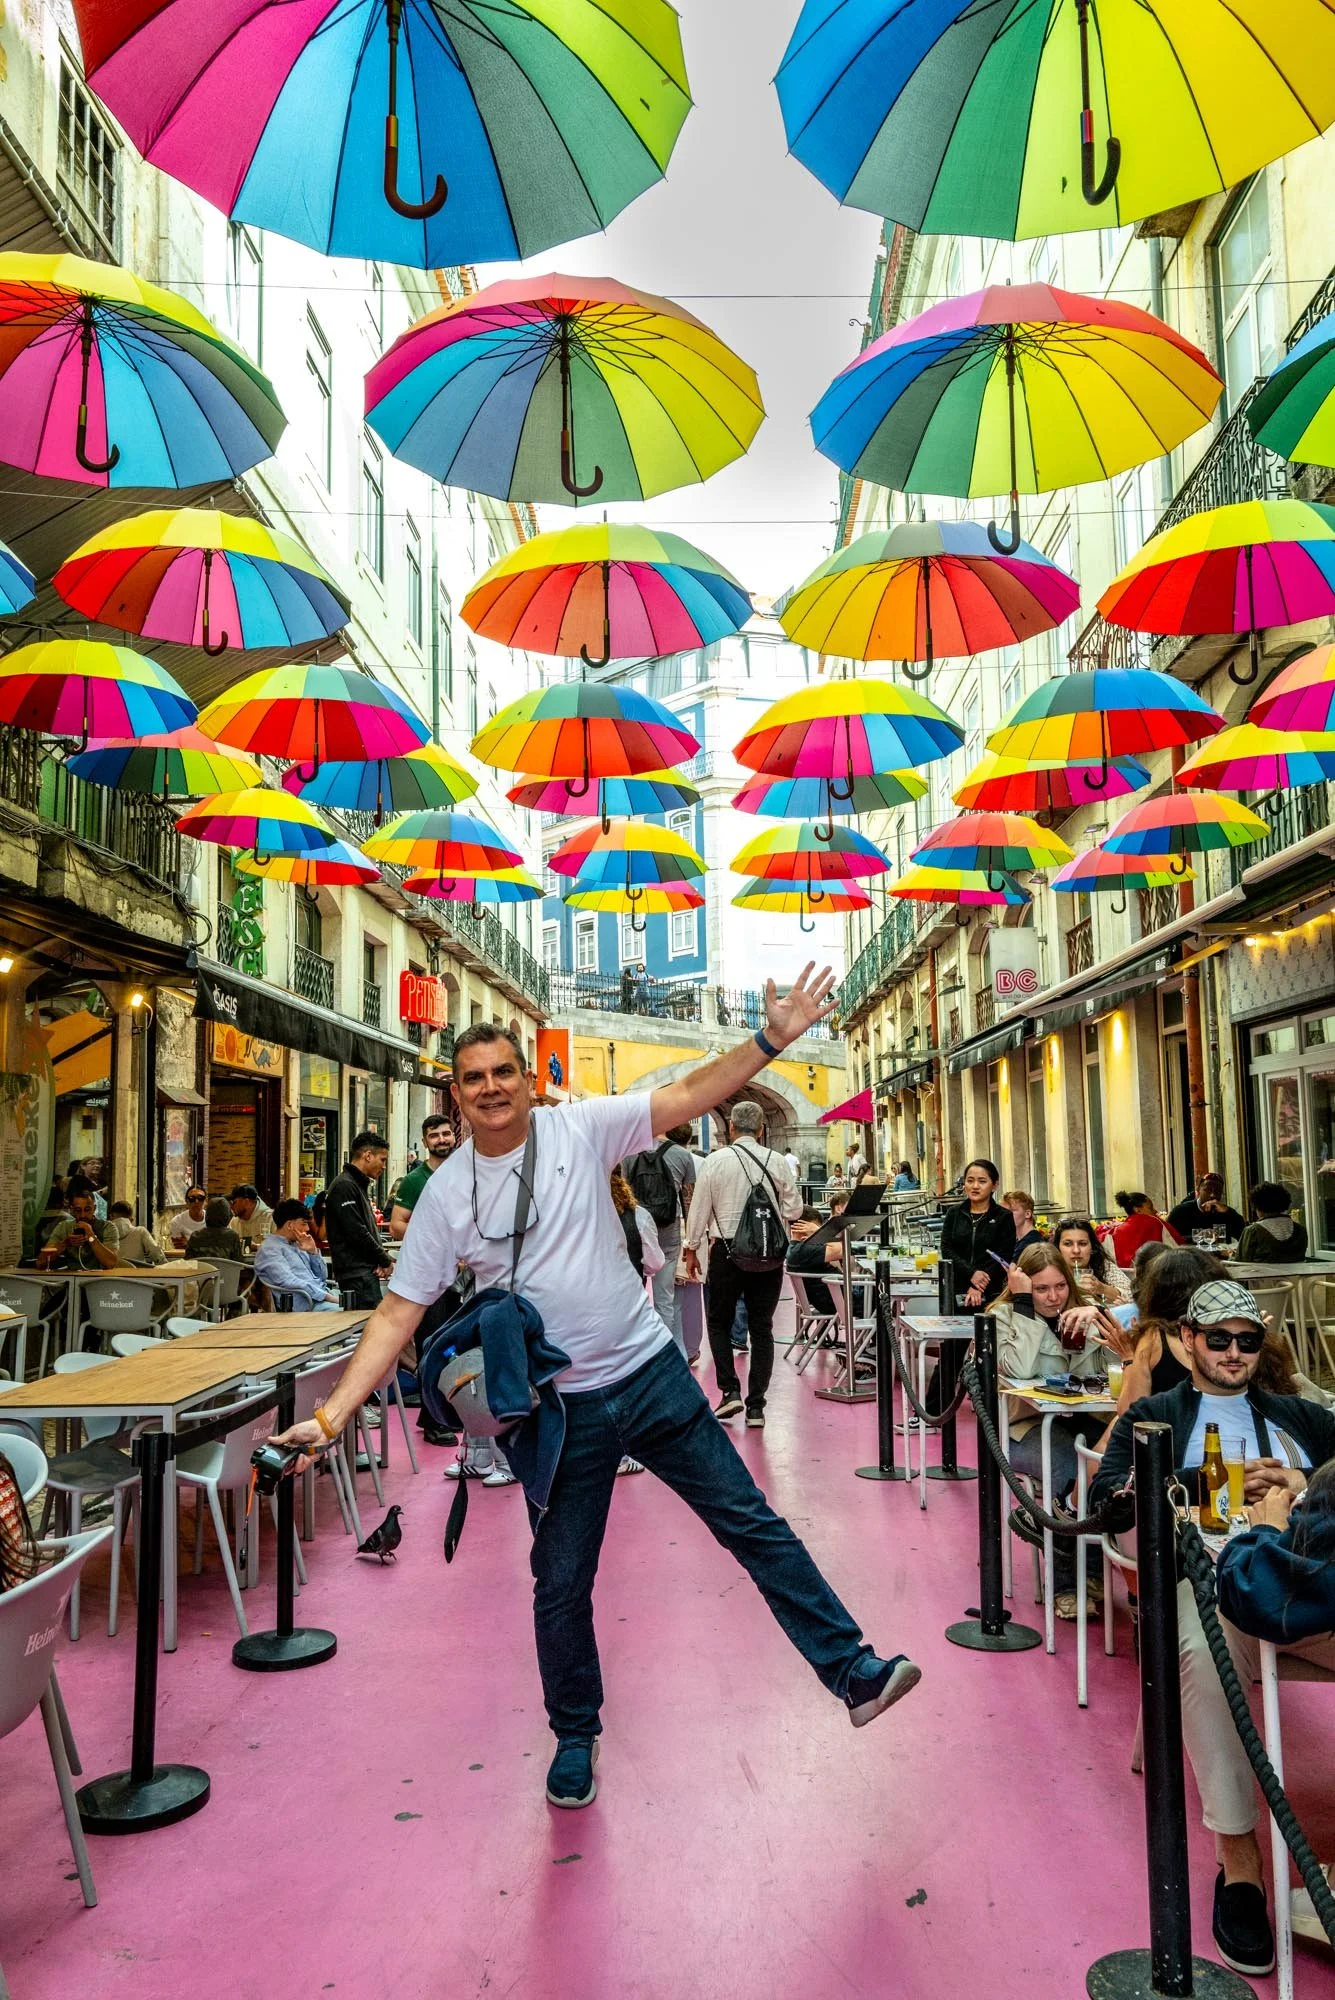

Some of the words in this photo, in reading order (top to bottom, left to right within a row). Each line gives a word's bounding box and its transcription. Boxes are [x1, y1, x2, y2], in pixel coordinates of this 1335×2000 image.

[238, 870, 255, 977] ESC
[996, 969, 1038, 993] BC
[213, 984, 238, 1015] OASIS
